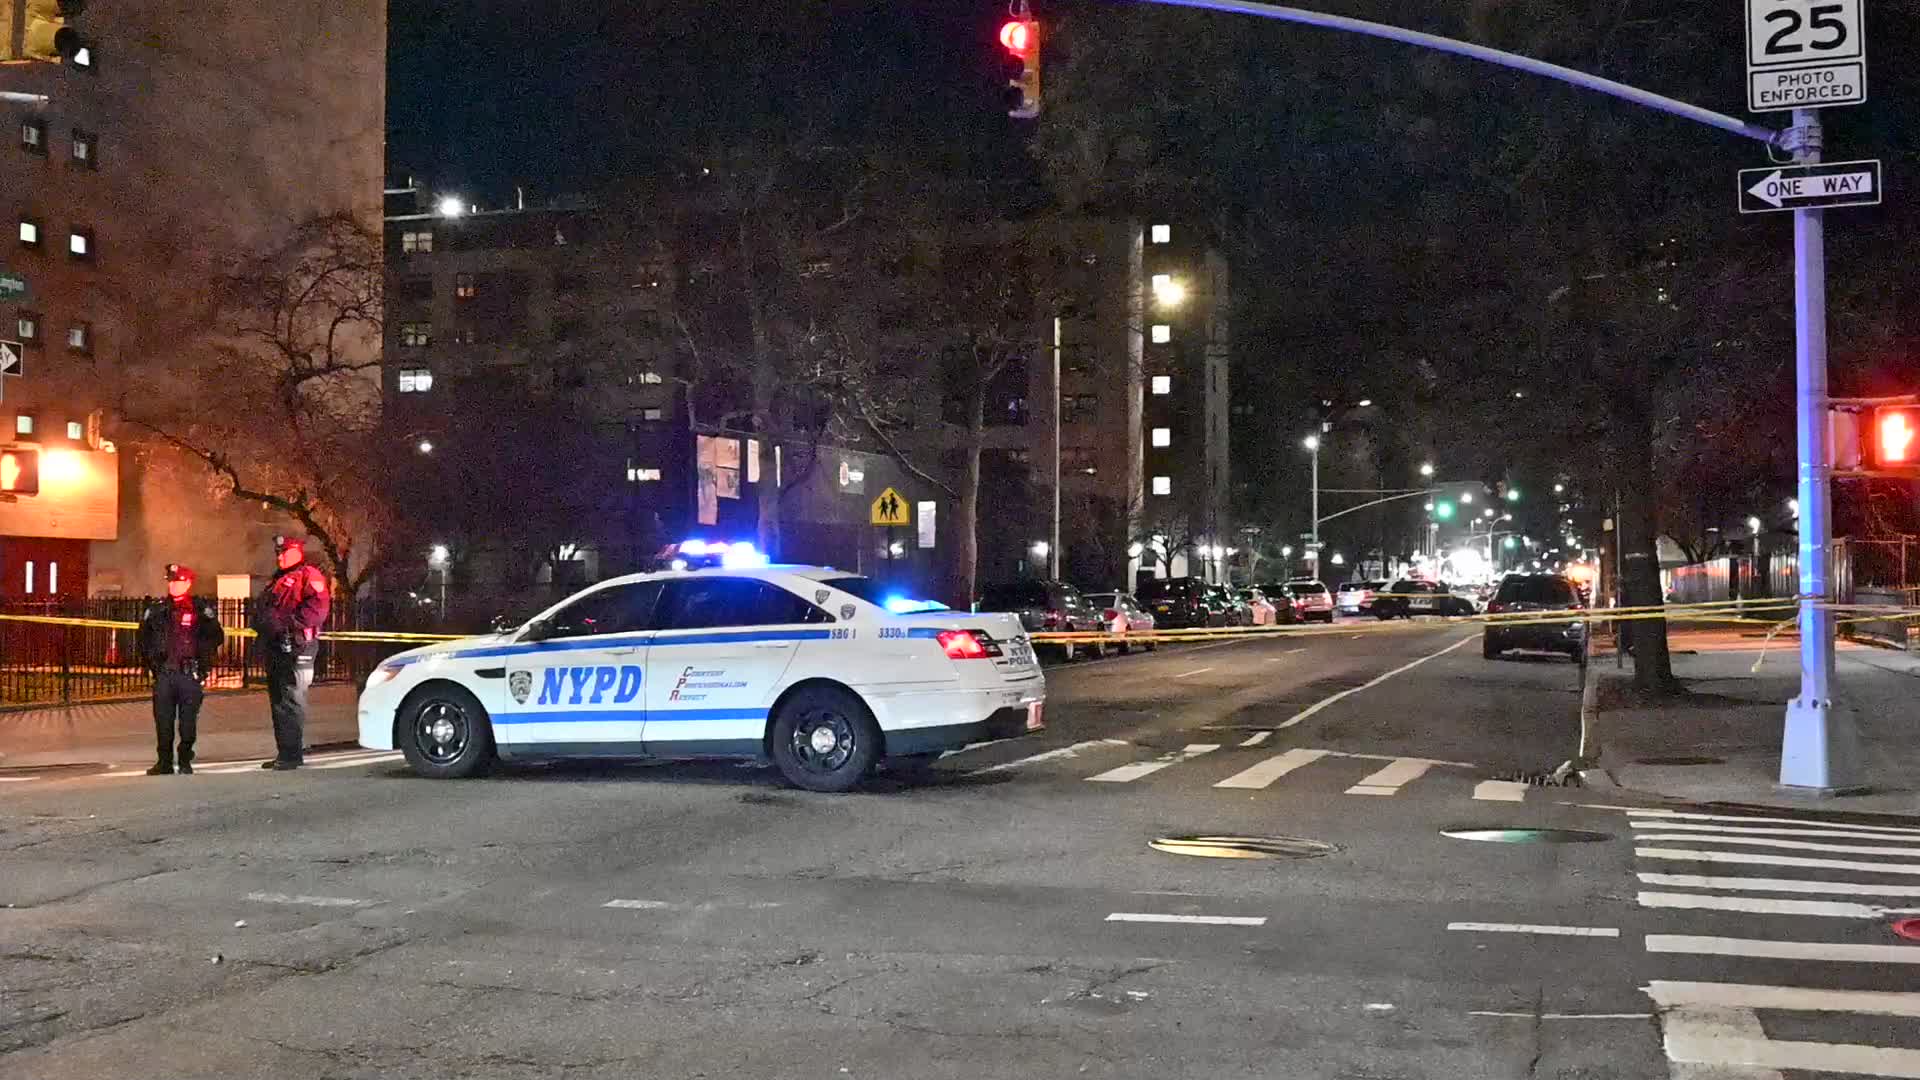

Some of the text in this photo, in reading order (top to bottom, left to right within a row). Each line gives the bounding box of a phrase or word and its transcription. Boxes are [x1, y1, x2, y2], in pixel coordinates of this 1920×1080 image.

[1764, 5, 1847, 55] 25
[1777, 71, 1835, 87] PHOTO
[1760, 84, 1853, 103] ENFORCED
[1766, 175, 1863, 198] ONE WAY
[537, 665, 642, 705] NYPD
